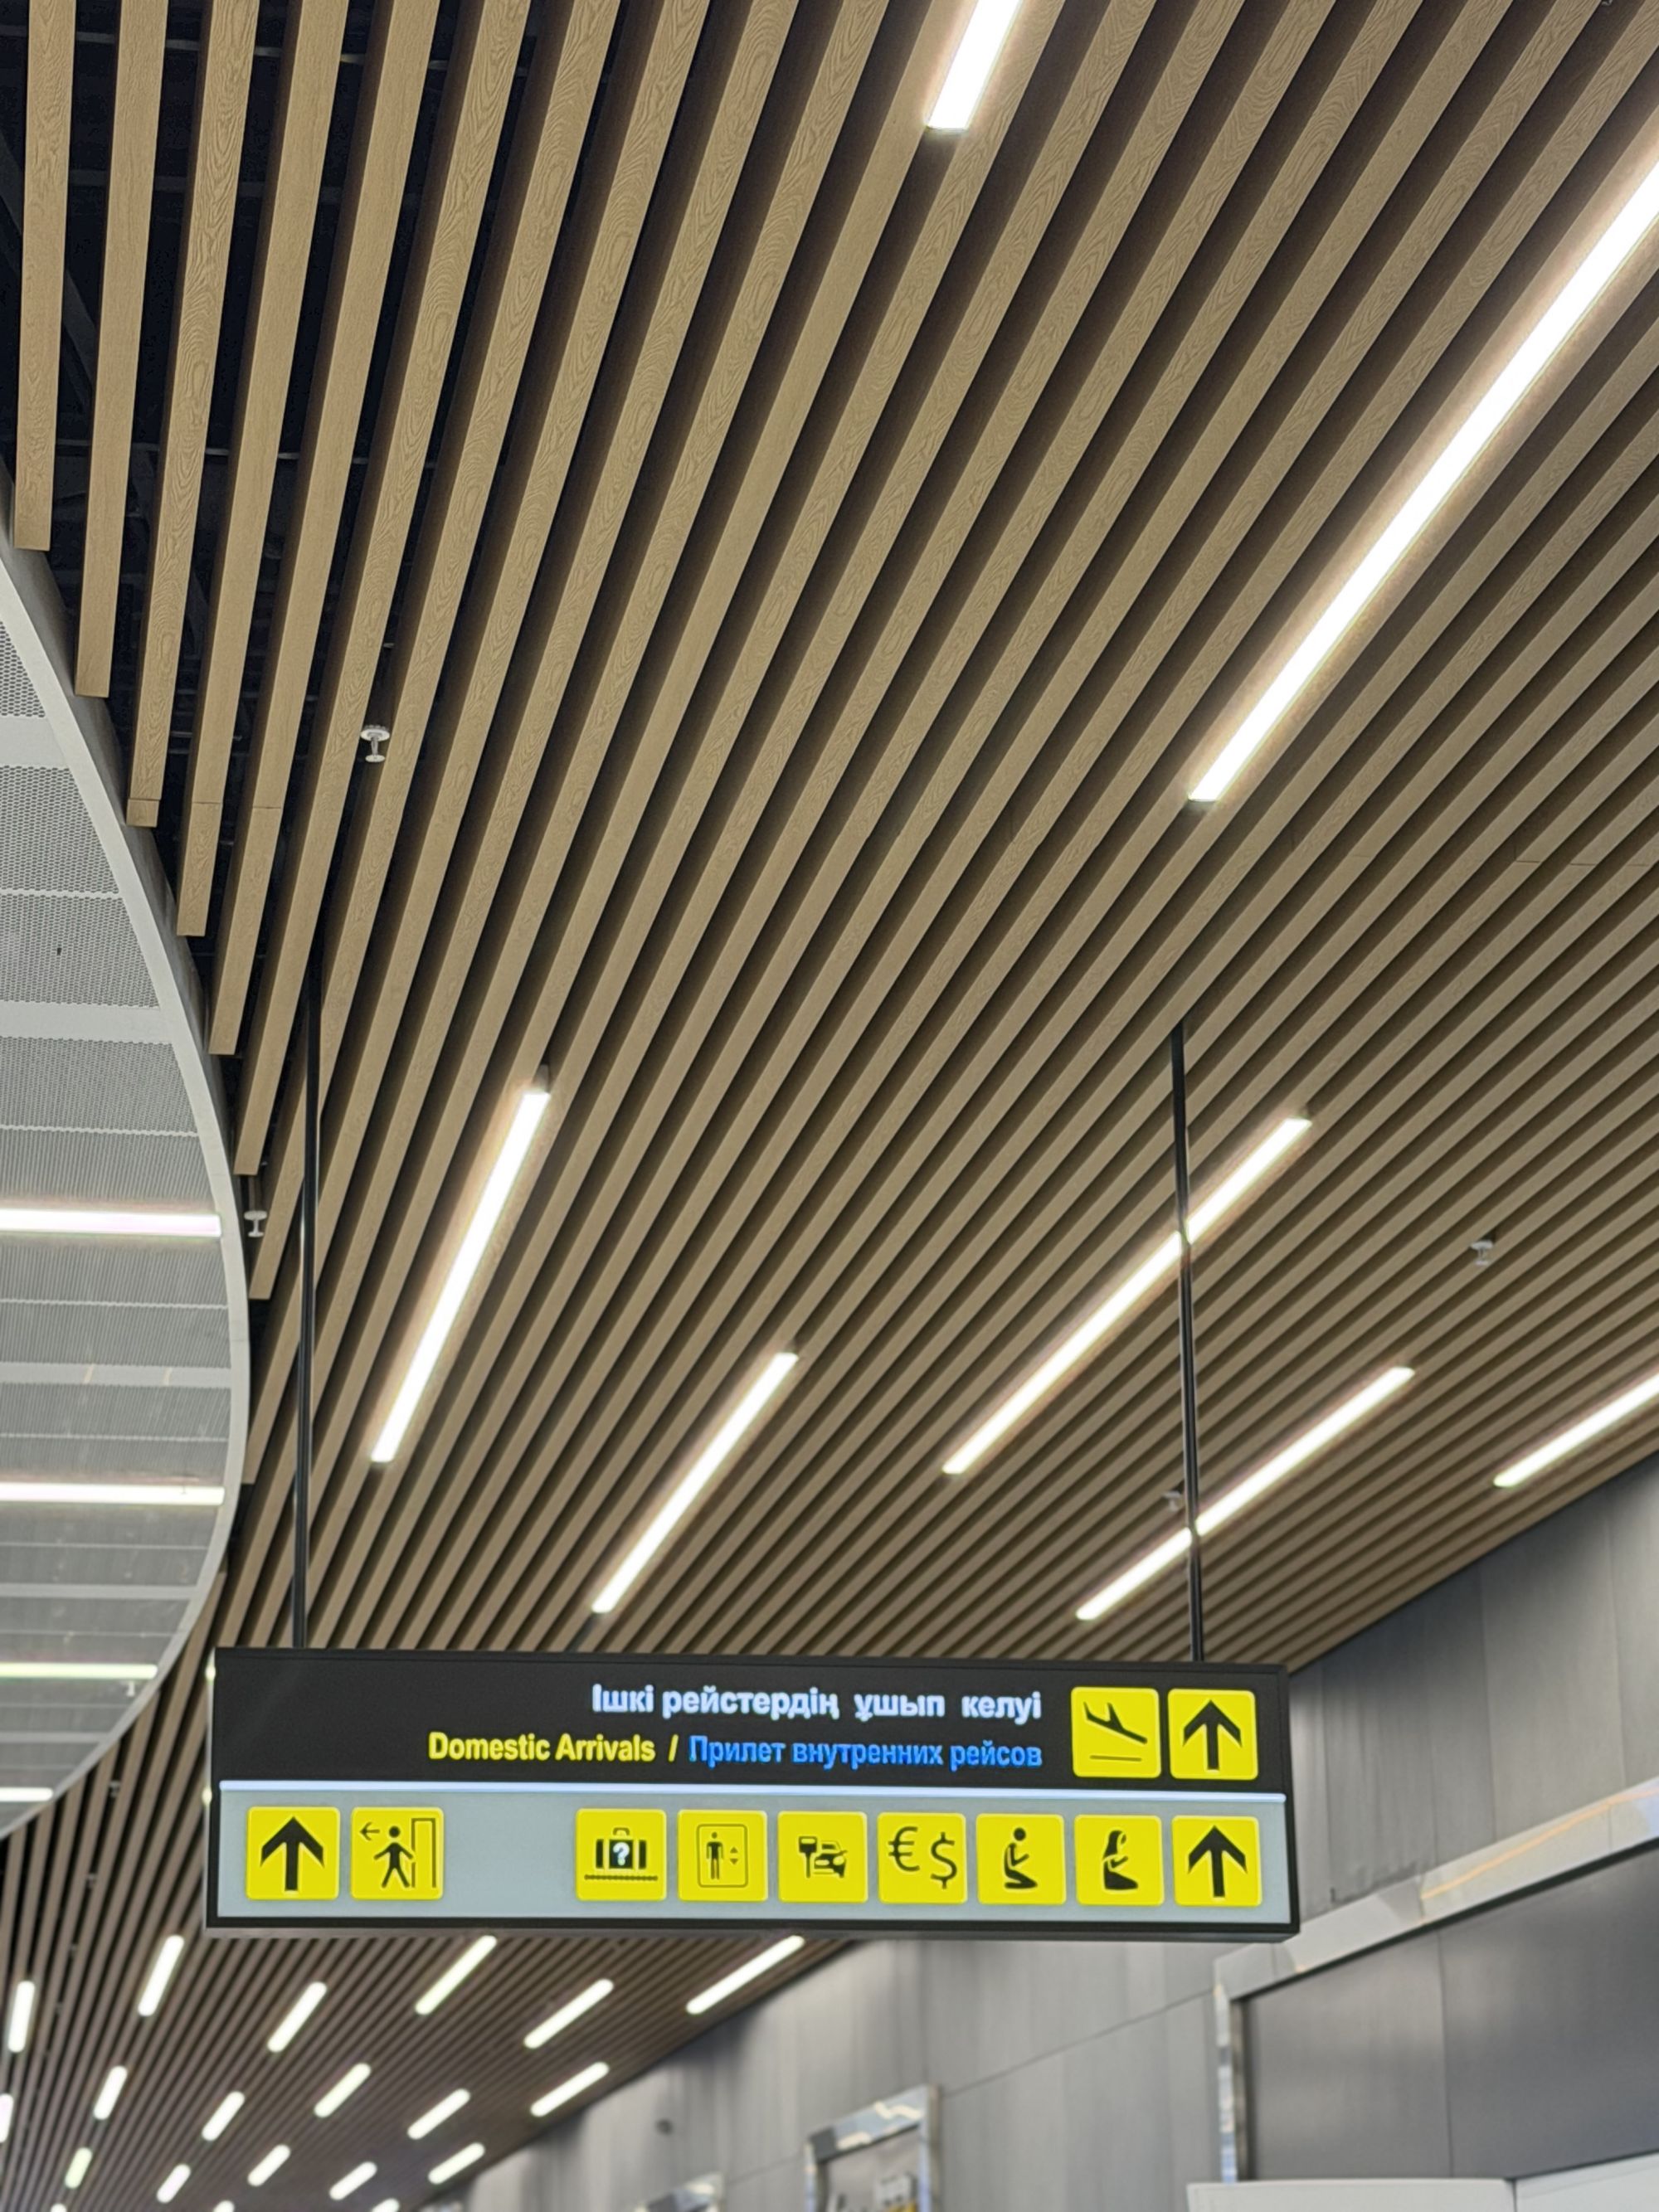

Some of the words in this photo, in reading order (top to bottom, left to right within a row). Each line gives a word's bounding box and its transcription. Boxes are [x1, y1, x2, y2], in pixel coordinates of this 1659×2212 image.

[591, 1683, 654, 1713] Ішкі
[661, 1685, 840, 1721] рейстердің
[853, 1693, 946, 1723] ұшып
[961, 1690, 1042, 1726] келуі
[428, 1731, 551, 1761] Domestic
[554, 1733, 656, 1762] Arrivals
[688, 1734, 786, 1769] Прилет
[791, 1742, 944, 1771] внутренних
[949, 1739, 1043, 1772] рейсов
